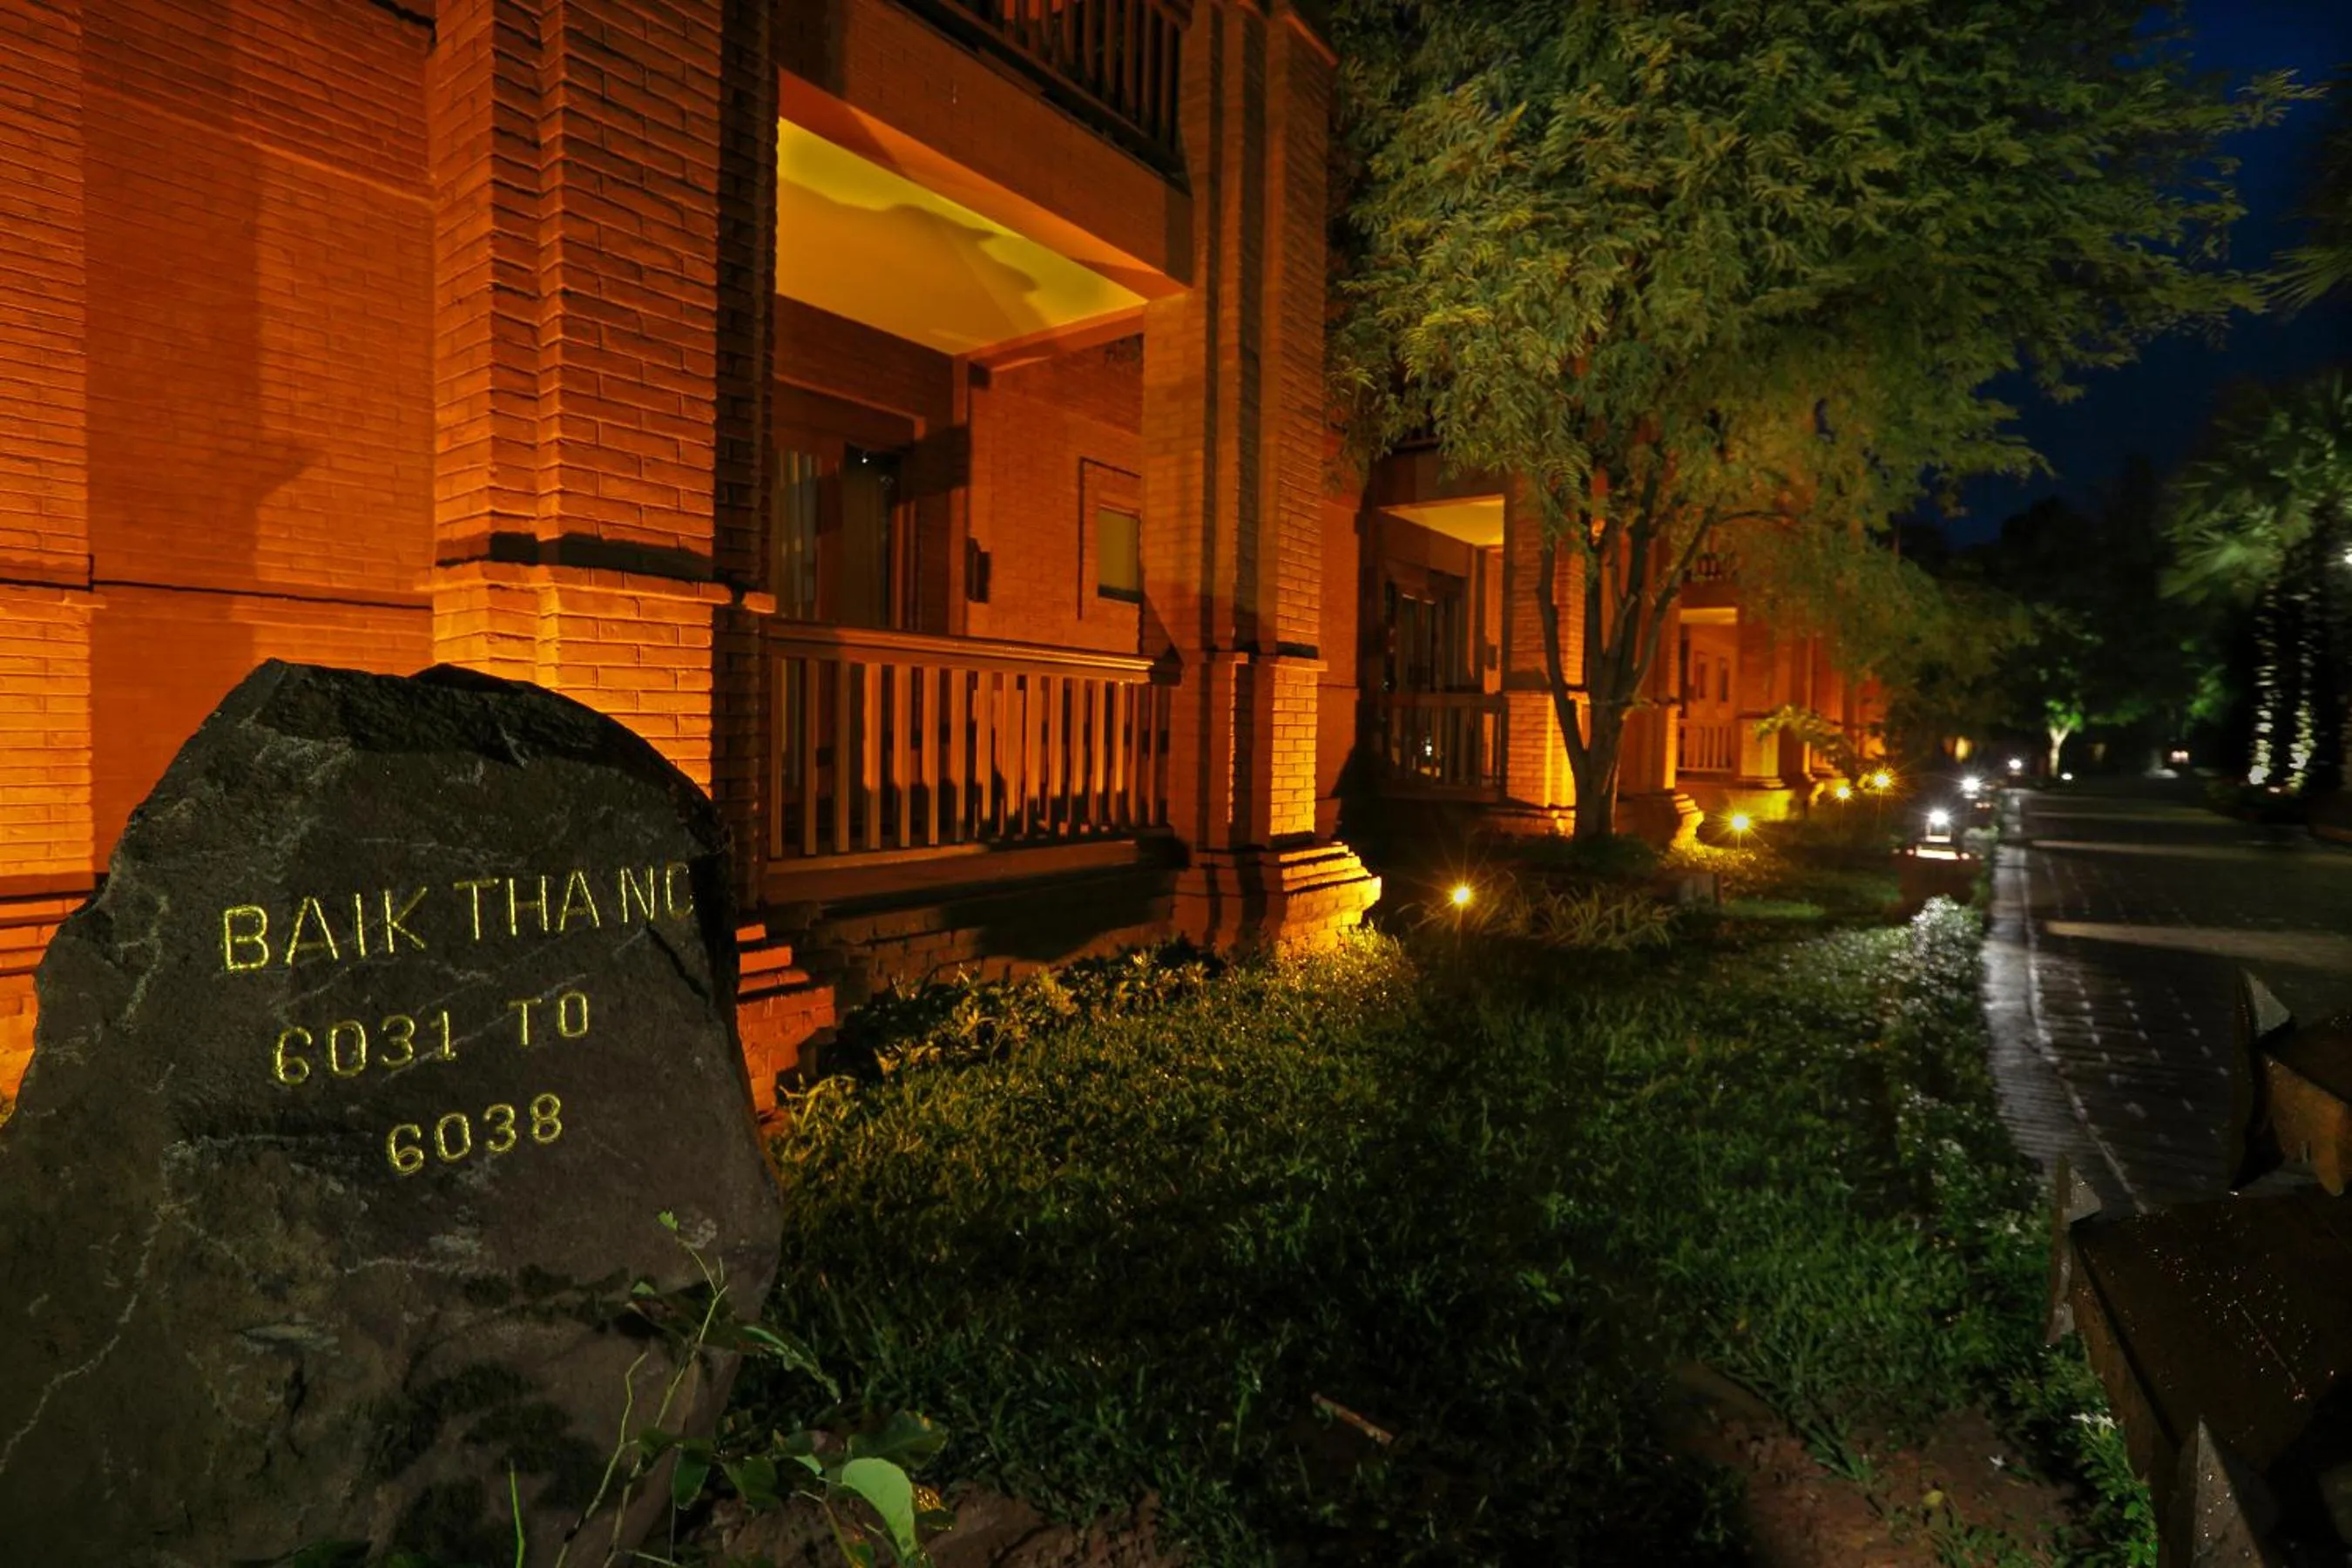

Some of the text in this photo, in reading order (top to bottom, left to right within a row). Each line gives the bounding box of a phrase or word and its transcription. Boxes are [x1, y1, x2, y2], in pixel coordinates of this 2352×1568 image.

[221, 887, 428, 971] BAIK
[273, 990, 589, 1085] 6031 TO
[387, 1092, 563, 1175] 6038
